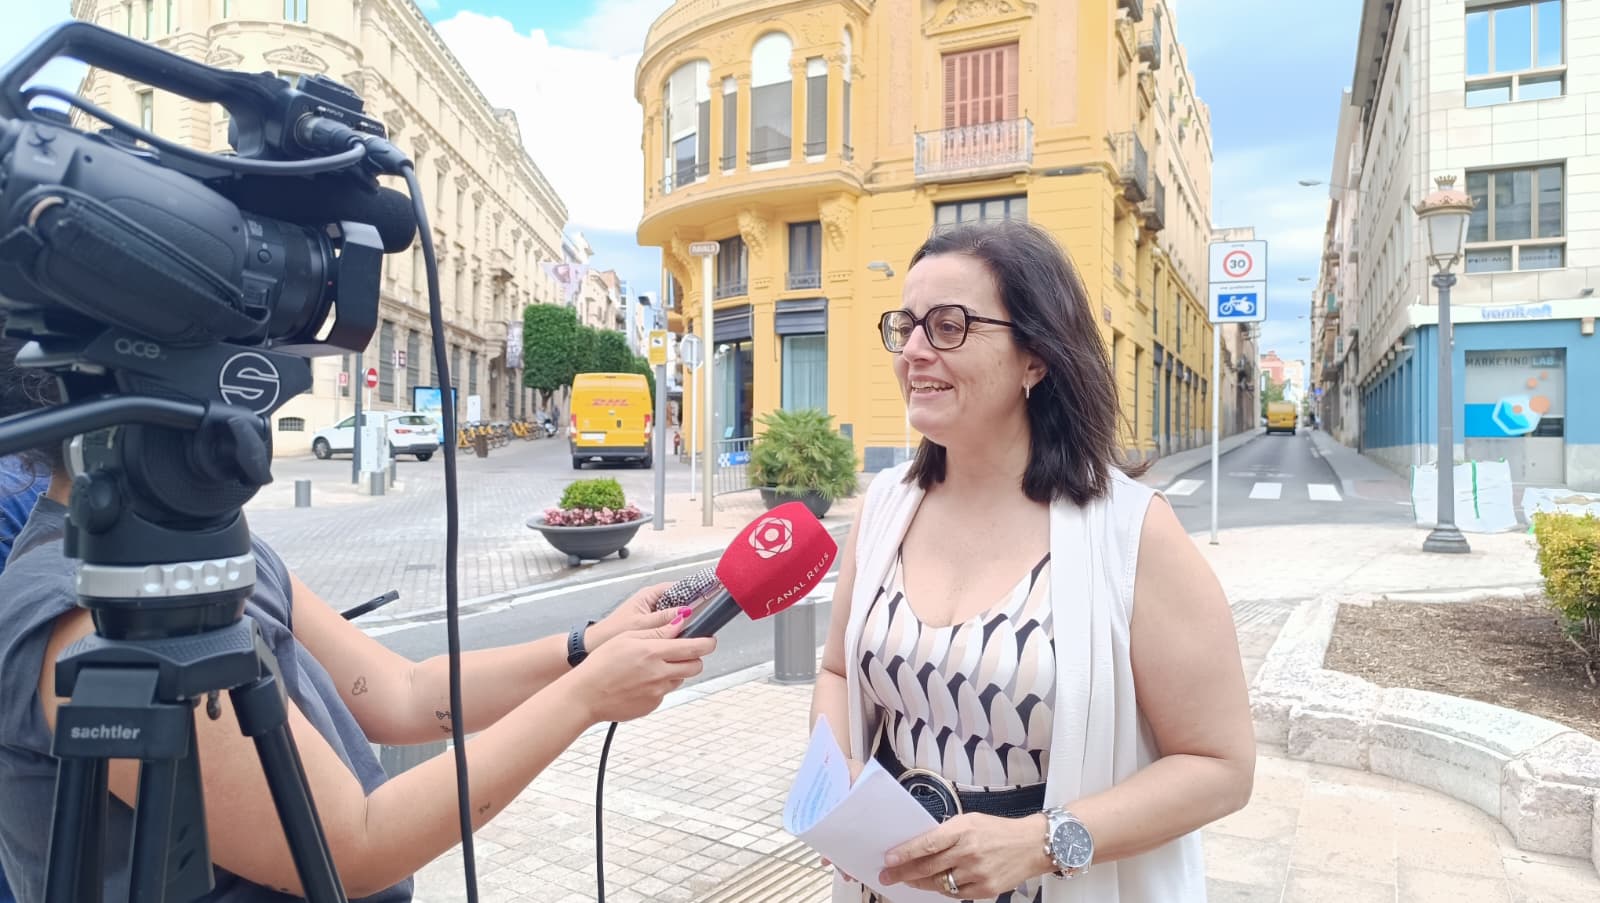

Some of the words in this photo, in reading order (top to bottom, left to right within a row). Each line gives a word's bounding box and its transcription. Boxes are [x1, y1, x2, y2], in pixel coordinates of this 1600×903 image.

[1229, 259, 1247, 269] 30
[115, 337, 160, 358] ace
[71, 724, 141, 740] sachtler
